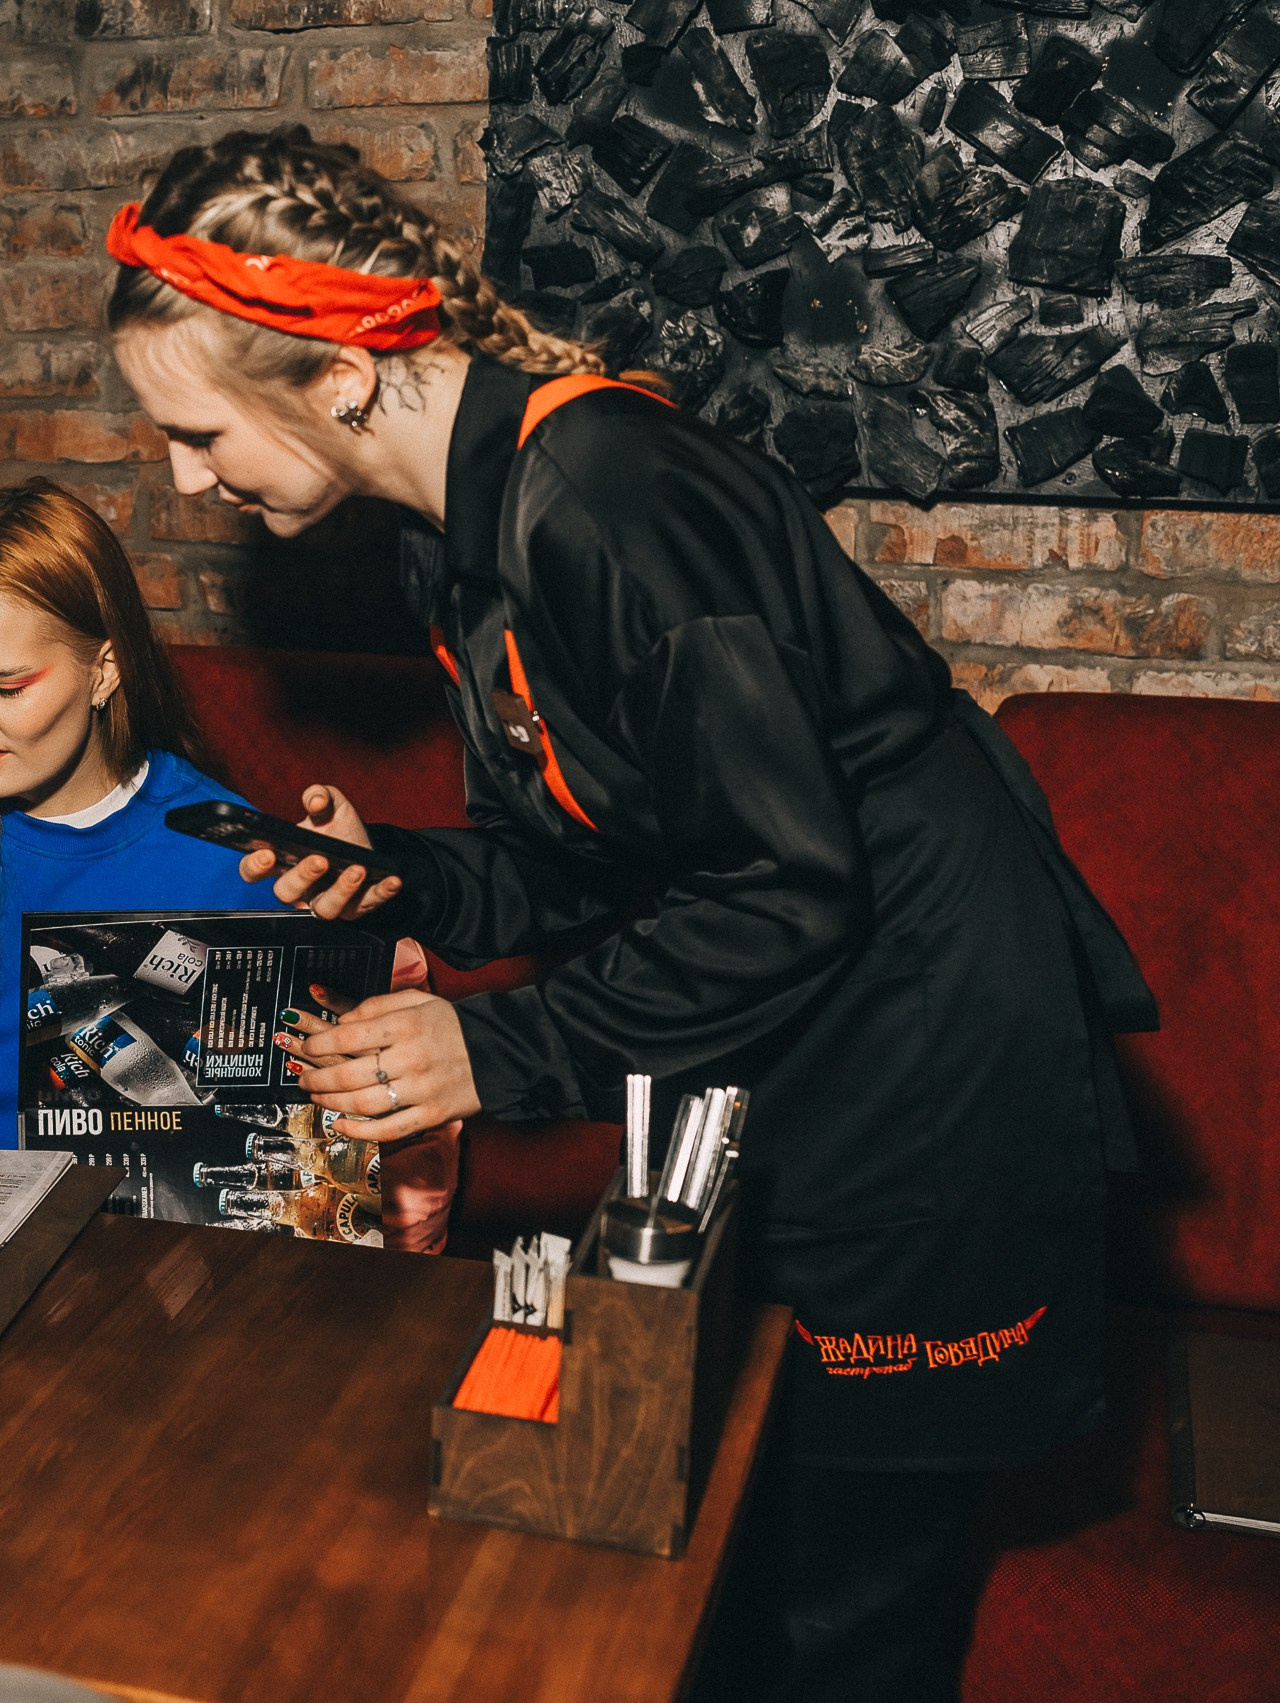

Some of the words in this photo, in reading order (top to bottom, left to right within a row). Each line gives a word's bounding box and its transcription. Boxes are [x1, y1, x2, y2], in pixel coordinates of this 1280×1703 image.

[149, 955, 196, 984] Rich
[177, 953, 203, 967] cola
[74, 1035, 96, 1056] tonic
[79, 1025, 114, 1058] Rich
[50, 1056, 66, 1072] cola
[60, 1053, 89, 1078] Rich
[206, 1054, 263, 1067] НАПИТКИ
[205, 1067, 262, 1078] ХОЛОДНЫЕ
[38, 1109, 102, 1136] ПИВО
[110, 1111, 182, 1131] ПЕННОЕ
[814, 1332, 917, 1363] ЖАДИНА
[923, 1322, 1029, 1368] ГОВЯДИНА
[825, 1358, 918, 1379] гастропаб
